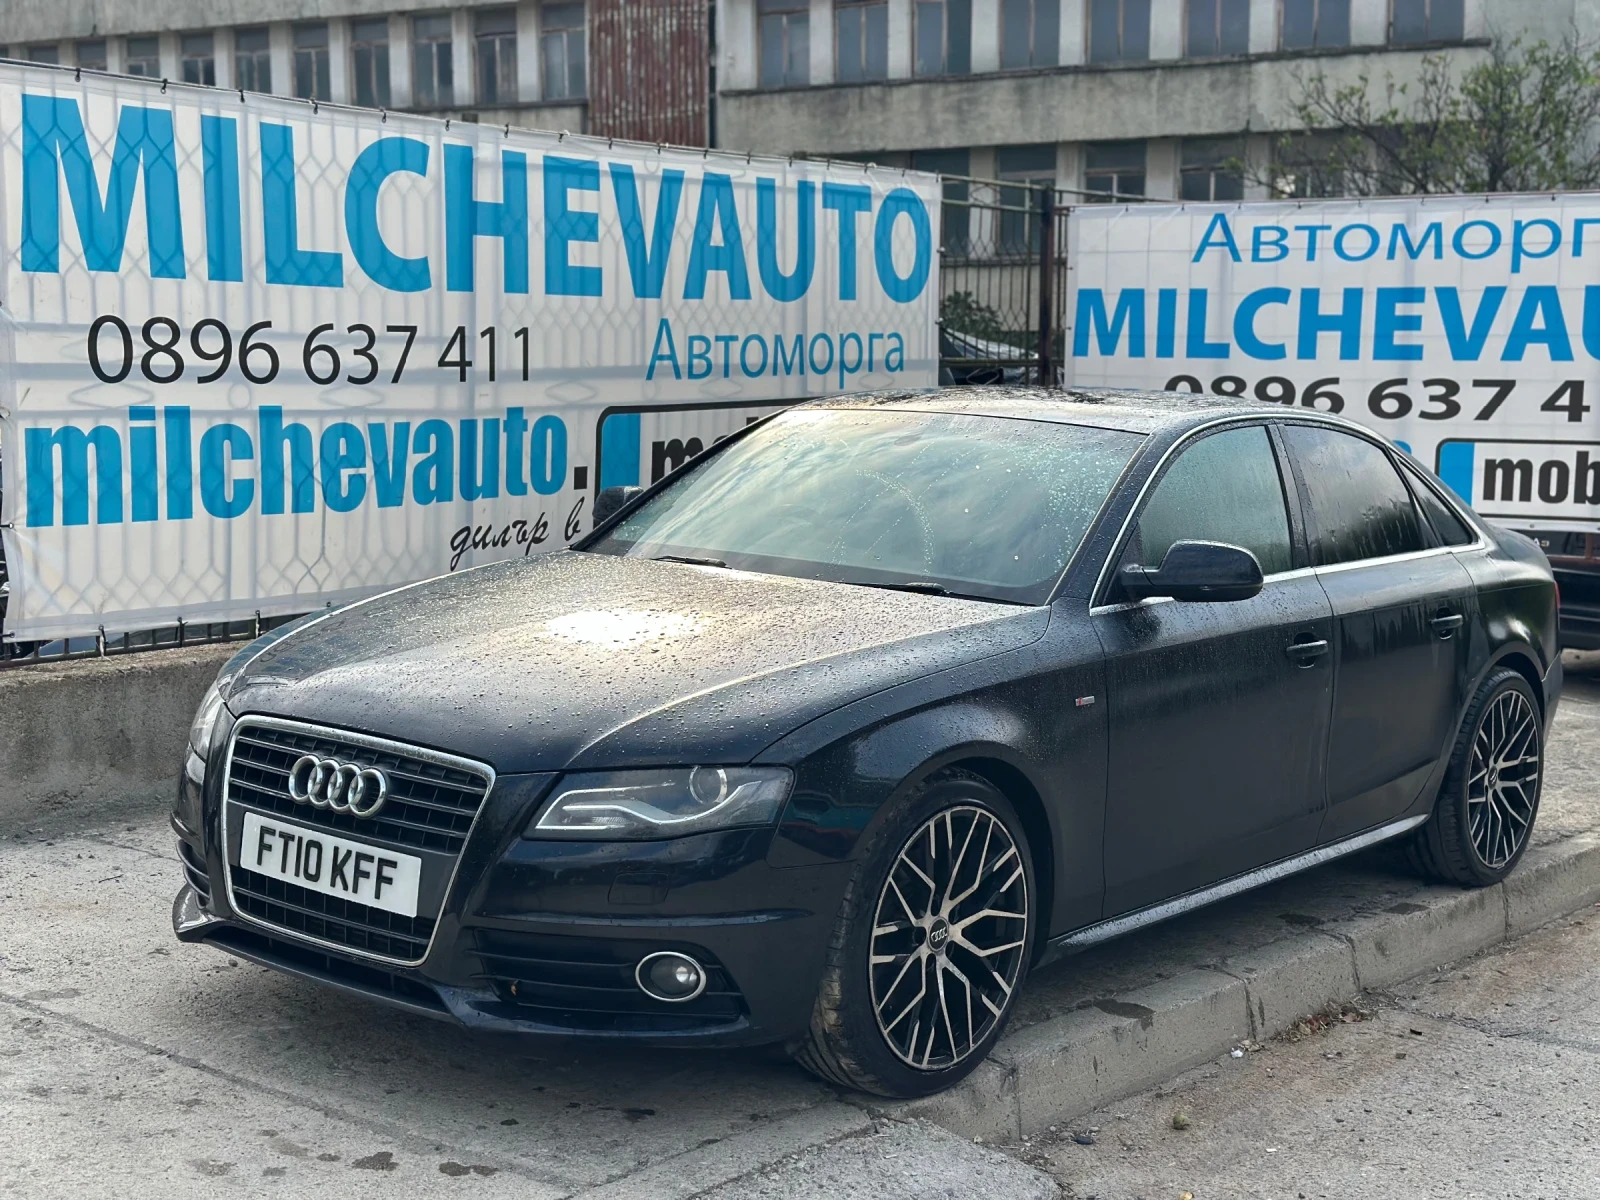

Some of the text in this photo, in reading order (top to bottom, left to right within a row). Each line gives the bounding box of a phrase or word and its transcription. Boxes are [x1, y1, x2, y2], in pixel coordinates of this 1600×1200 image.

[21, 93, 932, 304] MILCHEVAUTO
[87, 314, 530, 386] 0896 637 411
[646, 318, 904, 388] Автоморга
[1073, 286, 1600, 361] MILCHEVA
[1368, 377, 1517, 421] 637
[1540, 379, 1591, 422] 4
[1482, 450, 1600, 506] mob
[450, 496, 582, 572] дилър в
[257, 825, 398, 900] FT10 KFF
